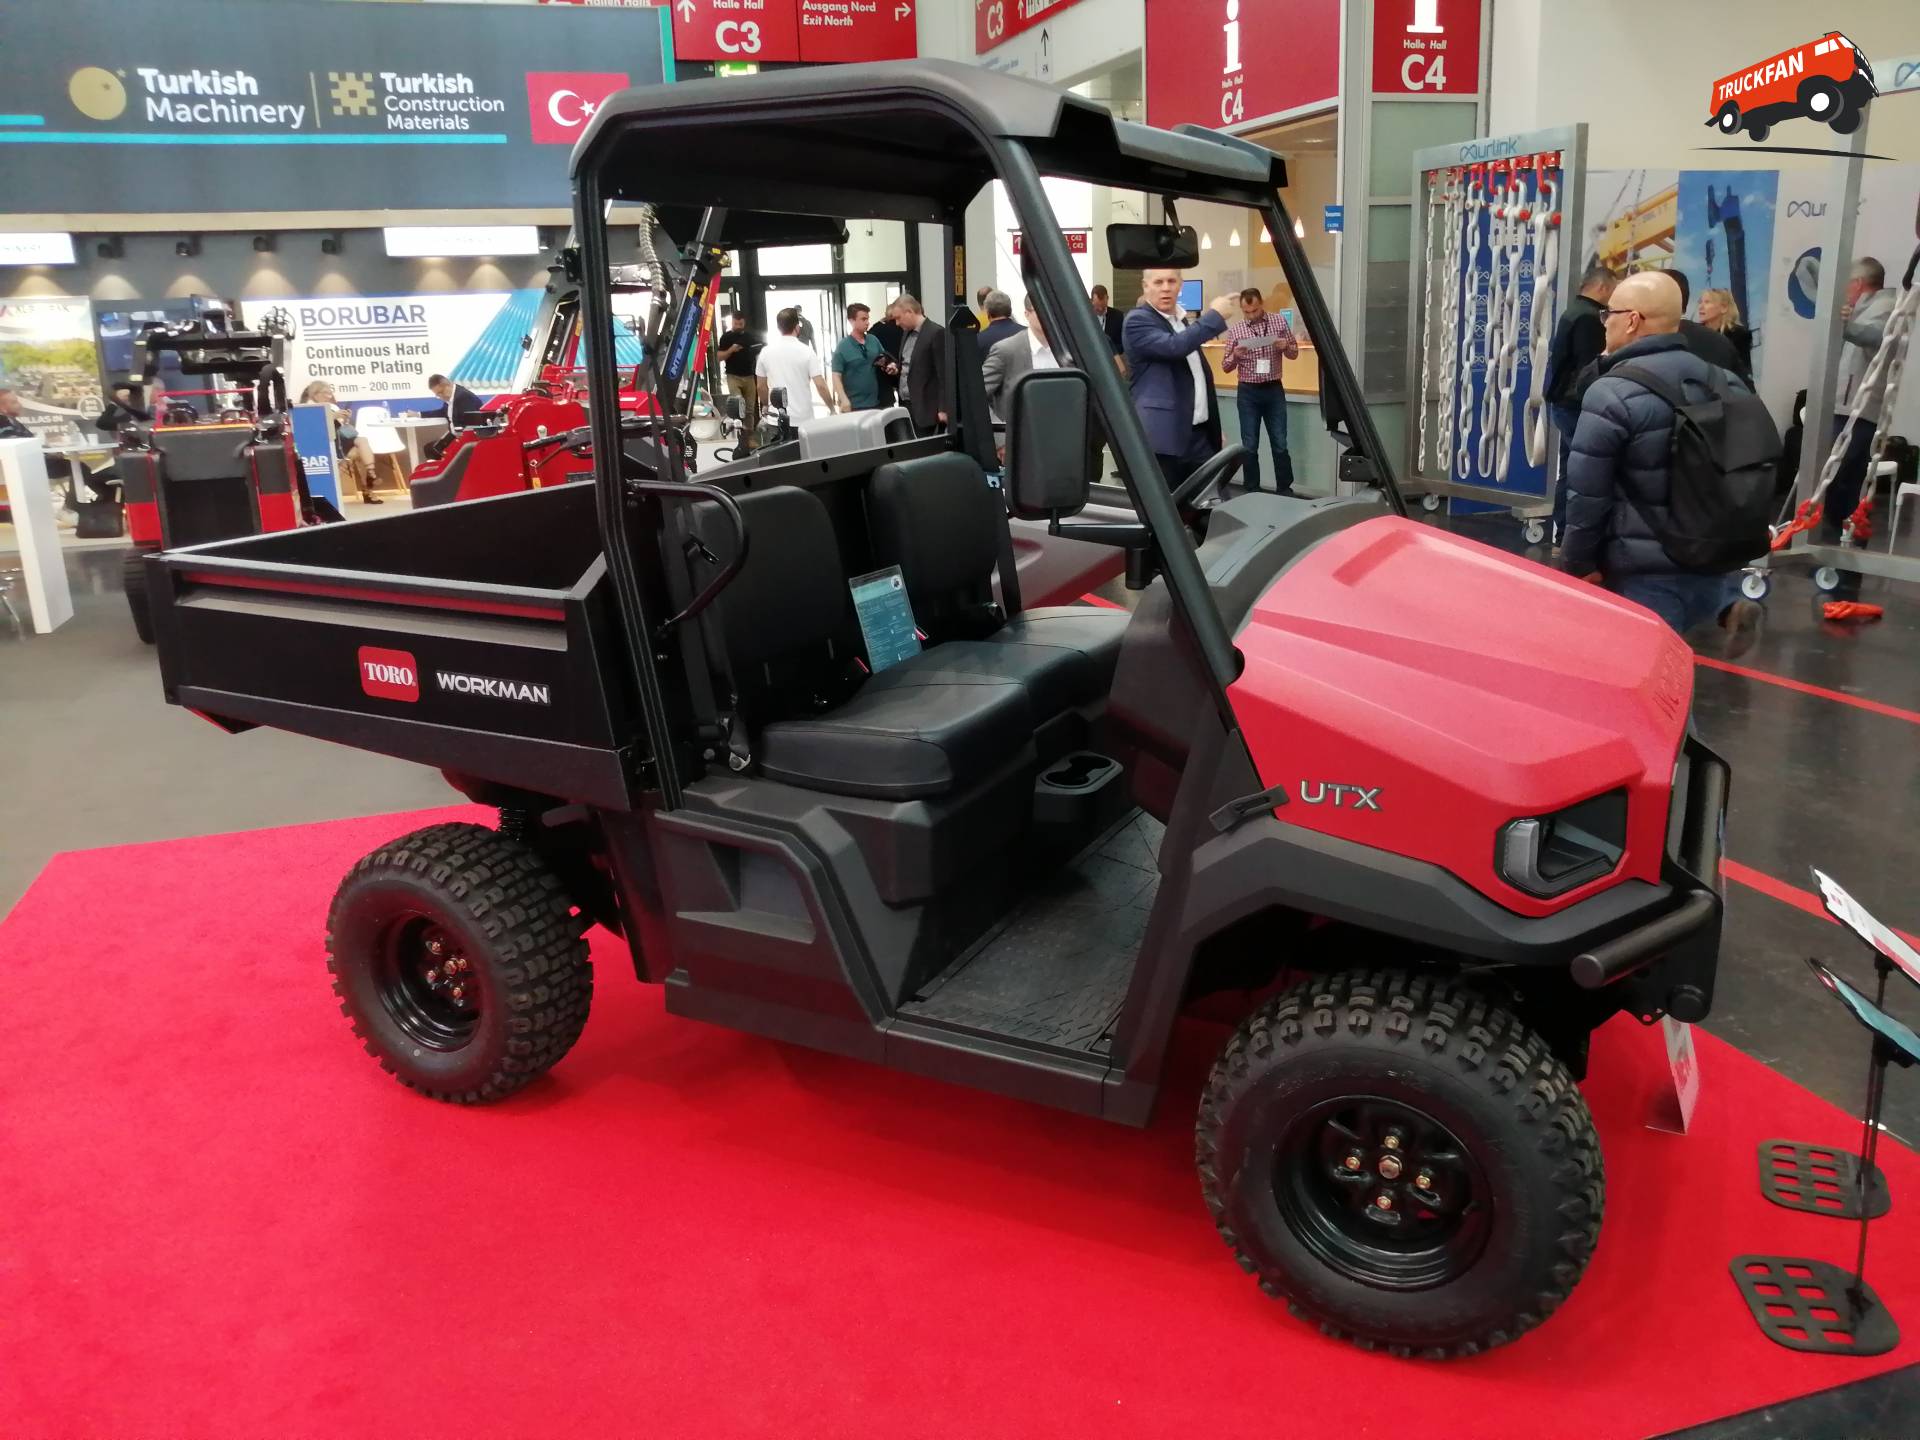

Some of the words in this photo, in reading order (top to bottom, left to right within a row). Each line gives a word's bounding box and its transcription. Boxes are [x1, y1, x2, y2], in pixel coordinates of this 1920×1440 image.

[713, 0, 741, 10] Halle
[744, 0, 764, 10] Hall
[802, 0, 849, 14] Ausgang
[851, 0, 877, 12] Nord
[802, 15, 822, 26] Exit
[824, 15, 853, 27] North
[987, 2, 1004, 40] C3
[715, 20, 762, 54] C3
[1403, 39, 1426, 50] Halle
[1430, 39, 1448, 50] Hall
[136, 67, 259, 96] Turkish
[379, 71, 474, 94] Turkish
[1401, 53, 1447, 91] C4
[145, 97, 306, 130] Machinery
[384, 95, 506, 113] Construction
[1221, 88, 1244, 124] C4
[386, 113, 470, 130] Materials
[300, 304, 427, 327] BORUBAR
[305, 344, 391, 360] Continuous
[395, 342, 430, 356] Hard
[308, 362, 366, 377] Chrome
[370, 360, 423, 375] Plating
[338, 384, 359, 393] mm
[369, 381, 389, 392] 200
[391, 382, 411, 391] mm
[363, 662, 414, 686] TORO
[436, 672, 548, 704] WORKMAN
[1300, 779, 1382, 811] UTX
